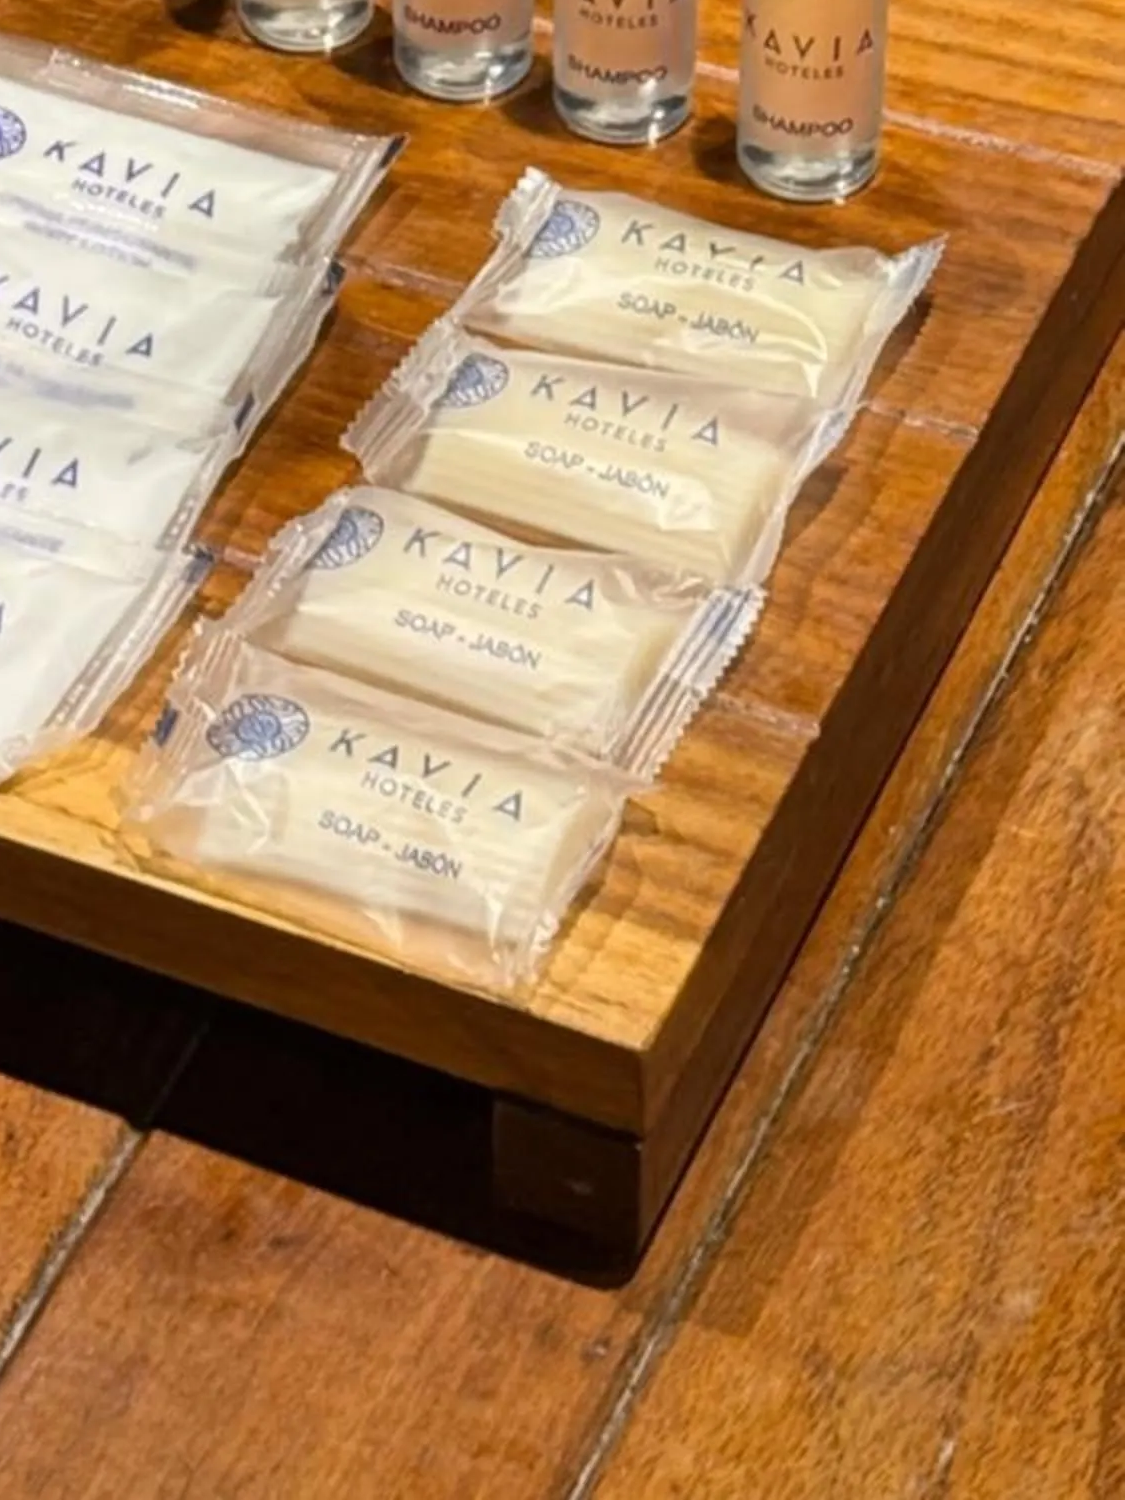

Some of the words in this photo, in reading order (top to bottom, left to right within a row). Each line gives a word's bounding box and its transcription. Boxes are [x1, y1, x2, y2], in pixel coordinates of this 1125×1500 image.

[404, 4, 501, 34] SHAMPOO
[578, 8, 658, 30] HOTELES
[568, 53, 668, 84] SHAMPOO
[764, 56, 843, 79] HOTELES
[753, 103, 853, 137] SHAMPOO
[43, 140, 216, 218] KAVIA
[71, 178, 167, 220] HOTELES
[654, 256, 757, 292] HOTELES
[6, 316, 105, 367] HOTELES
[617, 291, 677, 320] SOAP
[690, 311, 761, 344] JABÓN
[531, 374, 719, 447] KAVIA
[564, 412, 668, 453] HOTELES
[523, 441, 584, 470] SOAP
[598, 463, 671, 498] JABÓN
[403, 527, 596, 611] KAVIA
[436, 573, 545, 620] HOTELES
[394, 608, 456, 642] SOAP
[469, 632, 542, 671] JABÓN
[329, 728, 524, 822] KAVIA
[360, 771, 469, 824] HOTELES
[317, 809, 381, 846] SOAP
[395, 840, 464, 880] JABÓN
